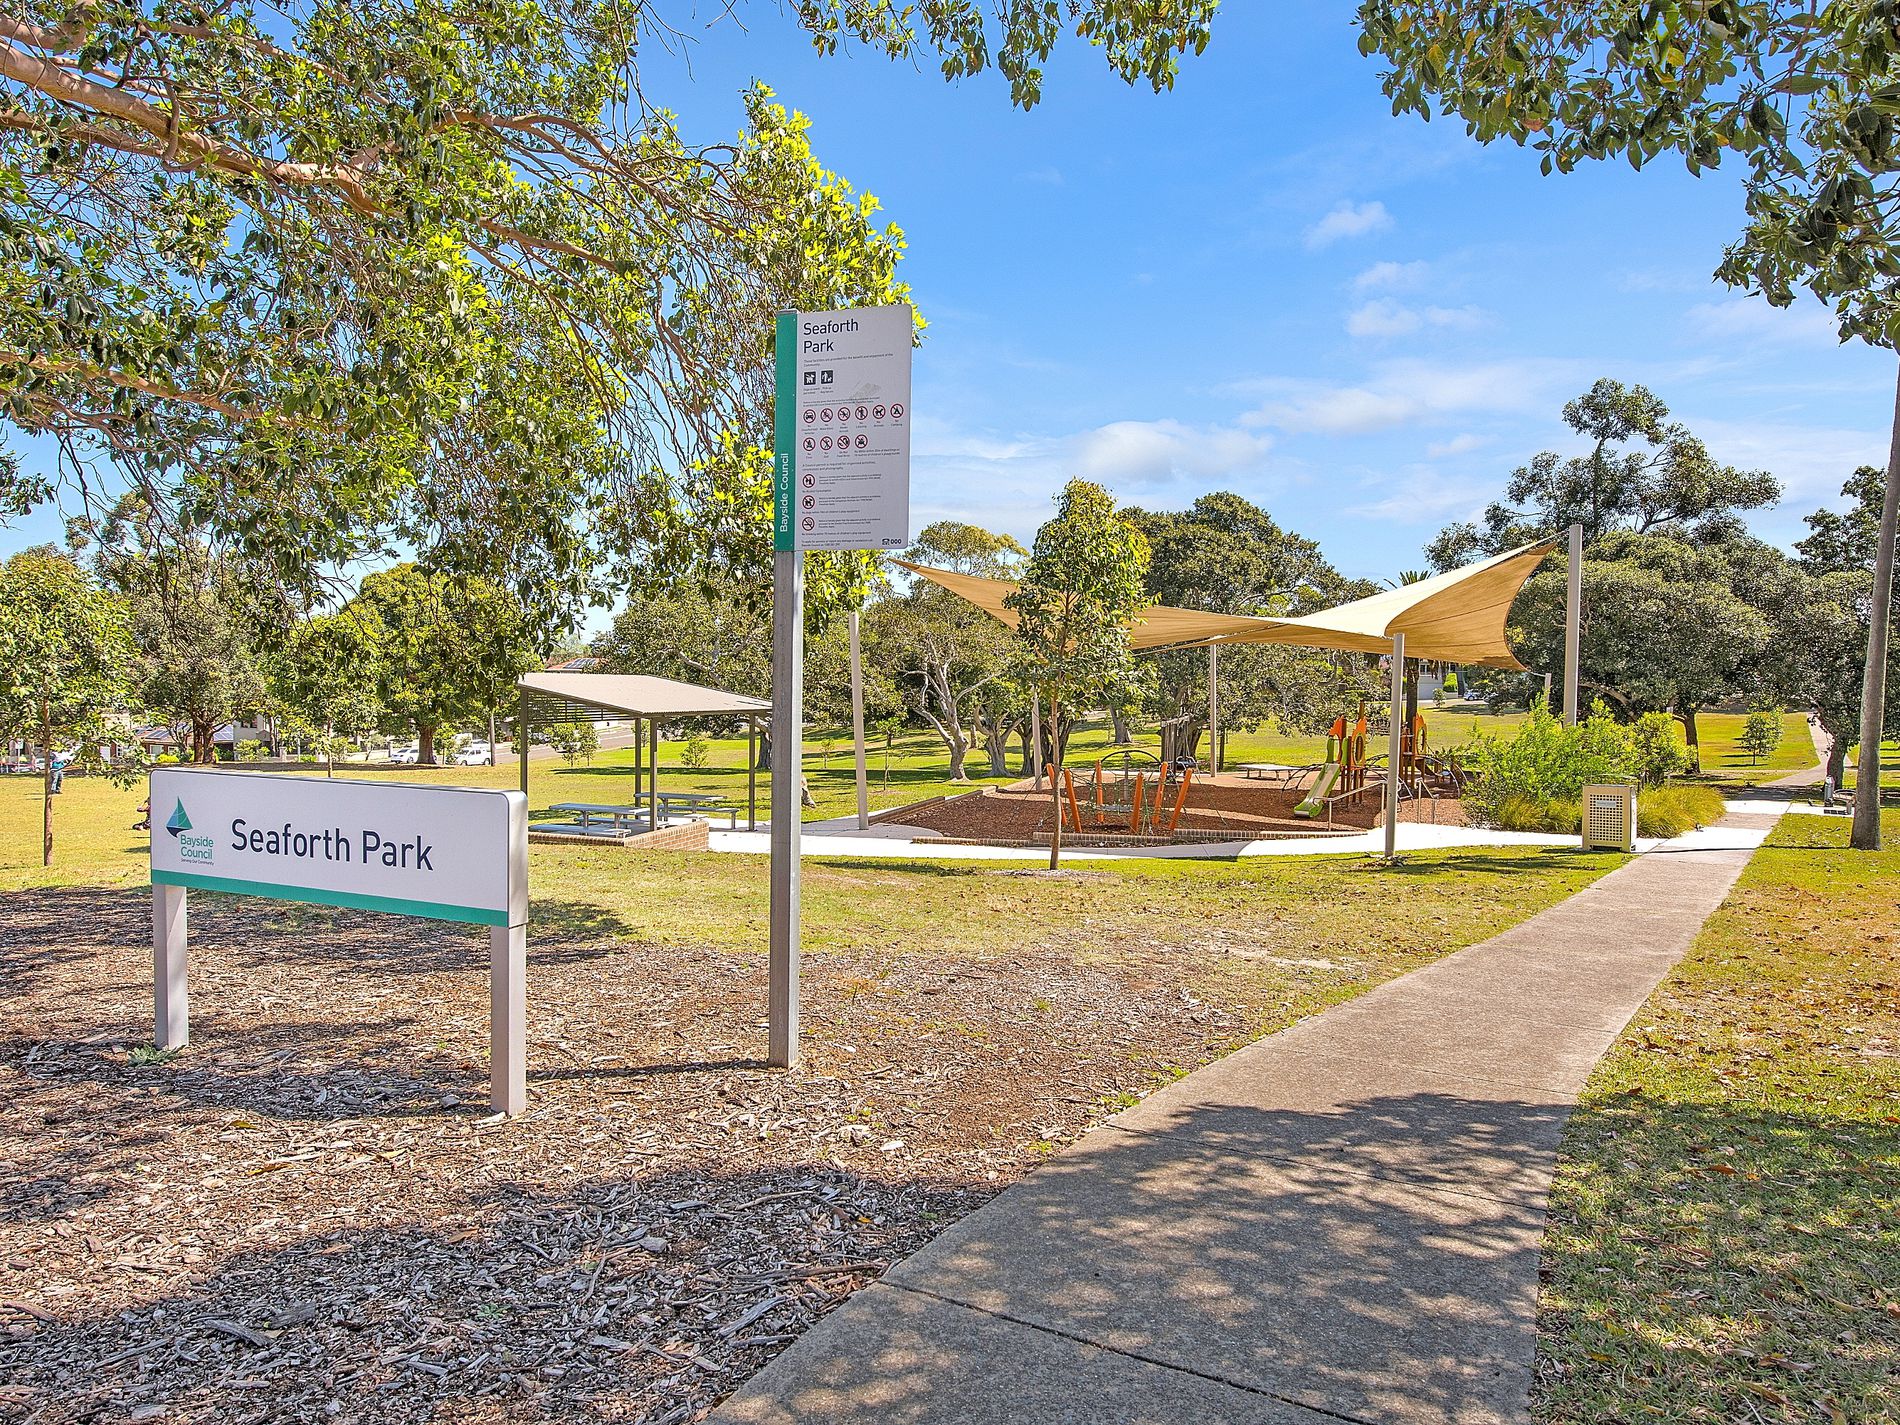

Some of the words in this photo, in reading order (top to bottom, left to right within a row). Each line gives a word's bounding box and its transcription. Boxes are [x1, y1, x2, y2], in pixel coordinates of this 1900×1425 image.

[803, 318, 859, 336] Seaforth
[803, 338, 834, 354] Park
[780, 453, 788, 490] Council
[780, 493, 789, 533] Bayside
[180, 834, 214, 848] Bayside
[231, 818, 351, 863] Seaforth
[362, 830, 434, 872] Park
[181, 846, 213, 860] Council
